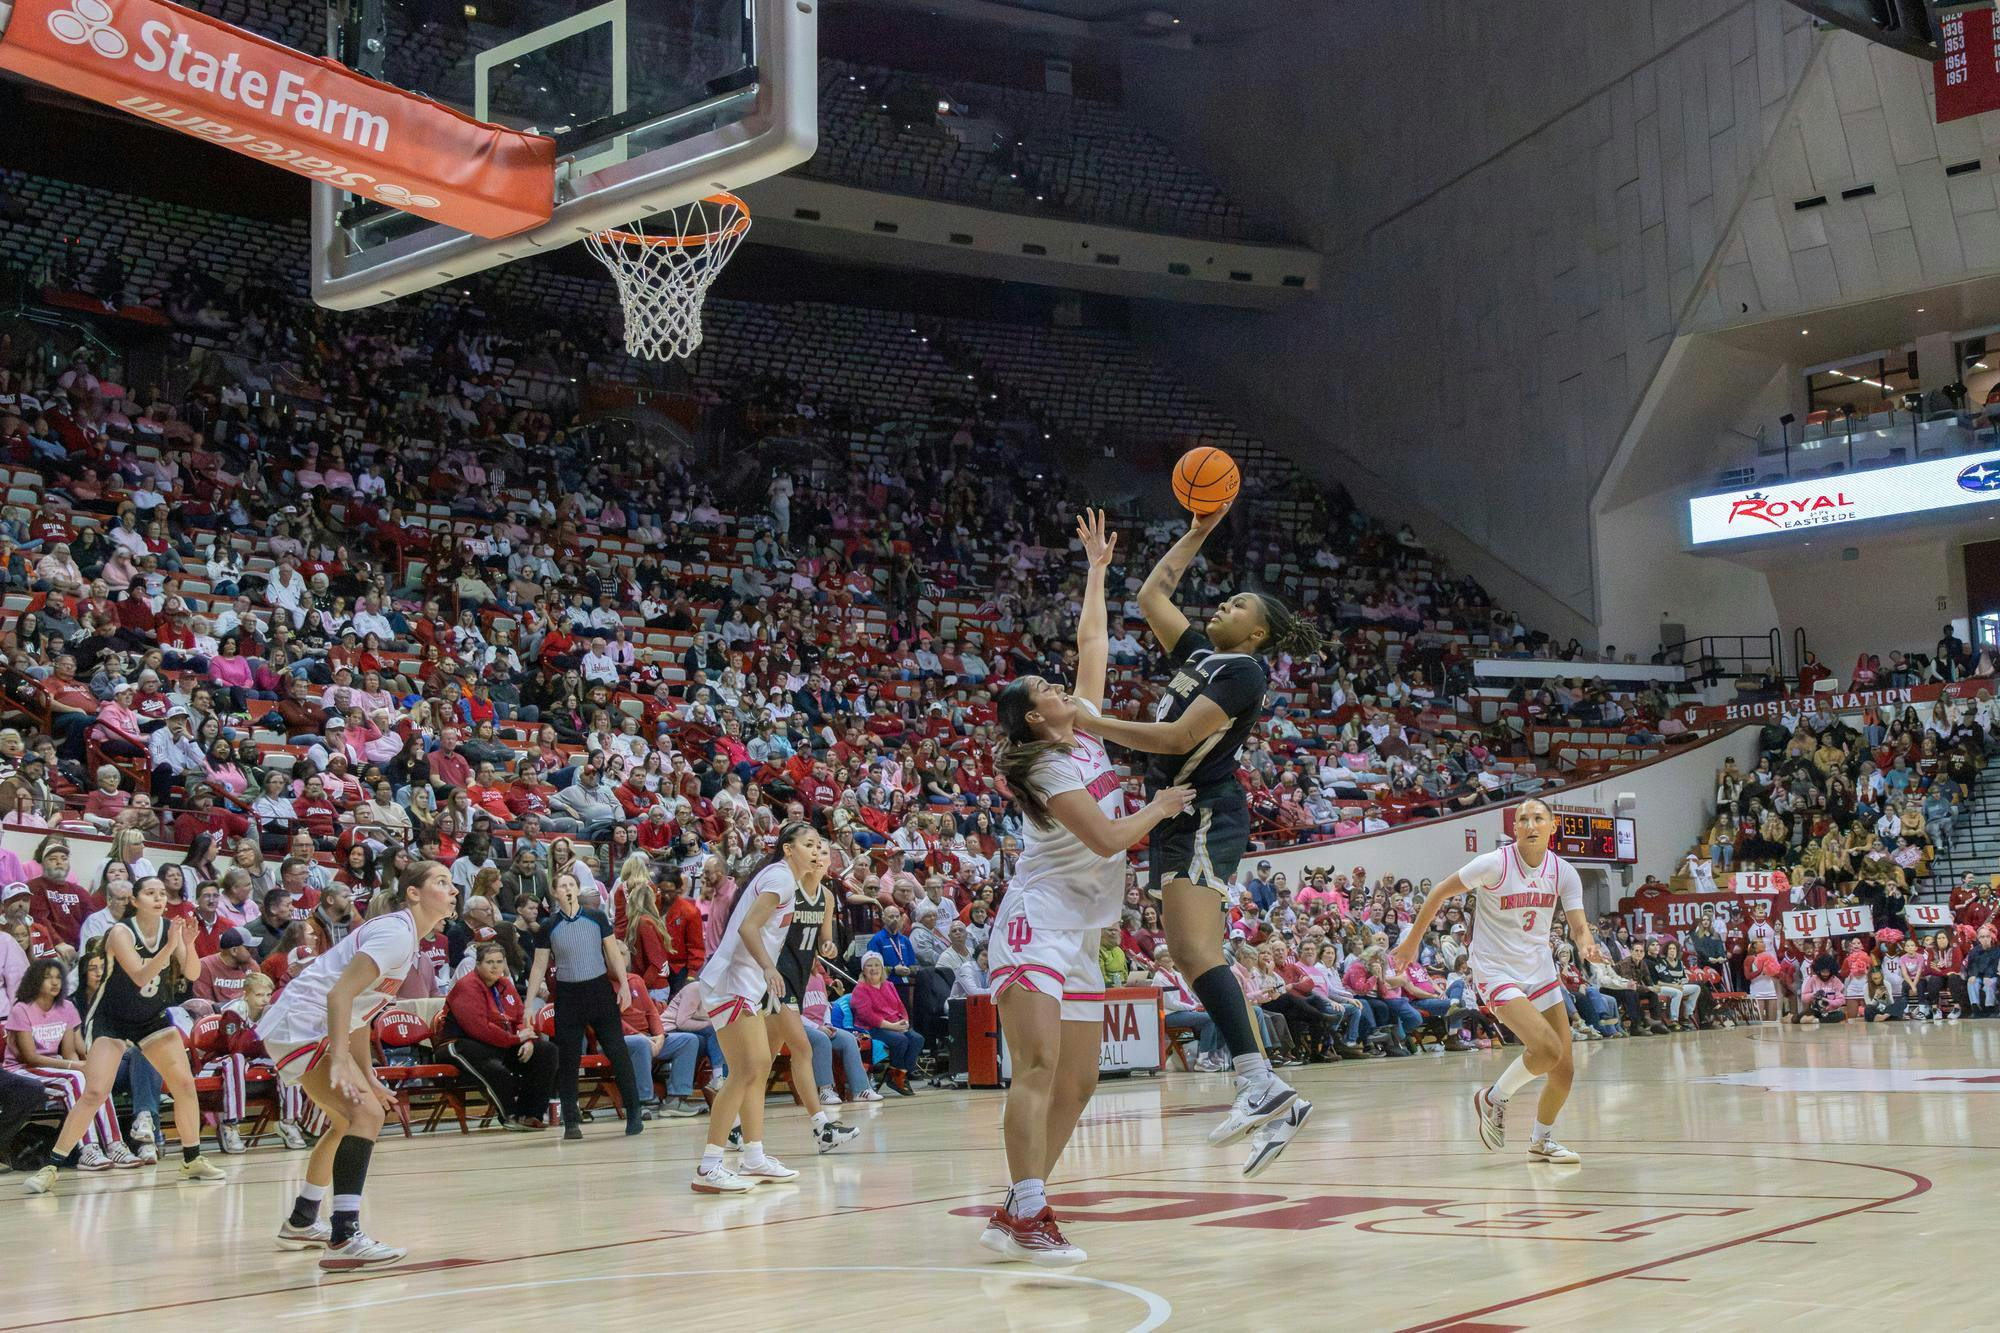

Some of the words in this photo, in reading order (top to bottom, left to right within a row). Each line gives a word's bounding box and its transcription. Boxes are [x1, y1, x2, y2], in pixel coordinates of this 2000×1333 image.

[1945, 52, 1967, 70] 1954
[1947, 67, 1967, 86] 1957
[1728, 492, 1854, 528] ROYAL
[1784, 512, 1856, 529] EASTSIDE
[1832, 687, 1912, 710] NATION
[1746, 873, 1767, 891] IU
[793, 911, 825, 924] PURDU
[1522, 910, 1537, 932] 3
[1793, 912, 1817, 936] IU
[1836, 908, 1861, 932] IU
[1915, 906, 1940, 923] IU
[799, 926, 818, 951] 11
[1008, 917, 1033, 953] IU
[140, 975, 161, 998] 8
[200, 1021, 220, 1034] INDI
[383, 1012, 422, 1027] INDIANA
[398, 1023, 409, 1037] IU
